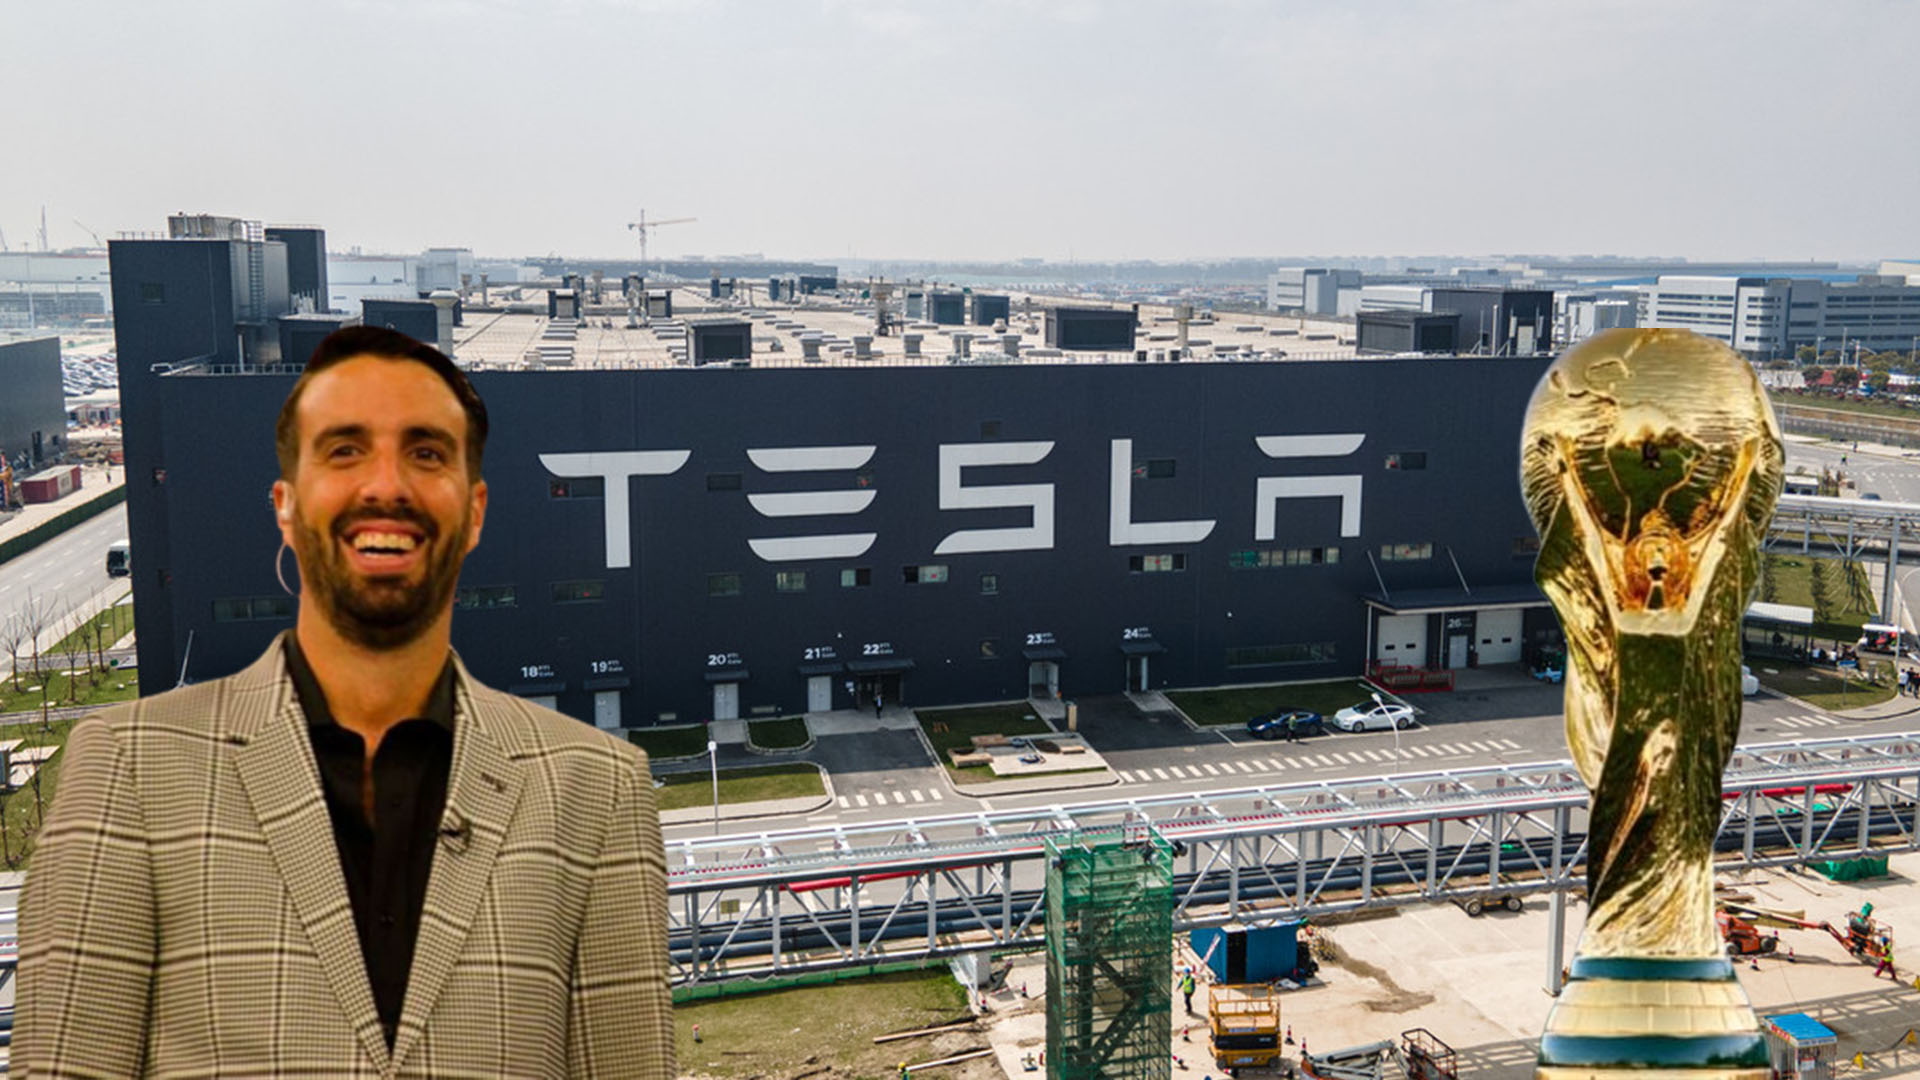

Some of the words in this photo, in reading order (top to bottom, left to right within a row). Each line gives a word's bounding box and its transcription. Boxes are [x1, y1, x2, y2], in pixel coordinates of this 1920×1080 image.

[538, 433, 1366, 568] TESLA
[1026, 633, 1042, 645] 23
[1123, 627, 1138, 639] 24
[804, 647, 821, 660] 21
[863, 643, 879, 655] 22
[707, 653, 726, 666] 20
[521, 665, 538, 678] 18
[591, 660, 607, 673] 19
